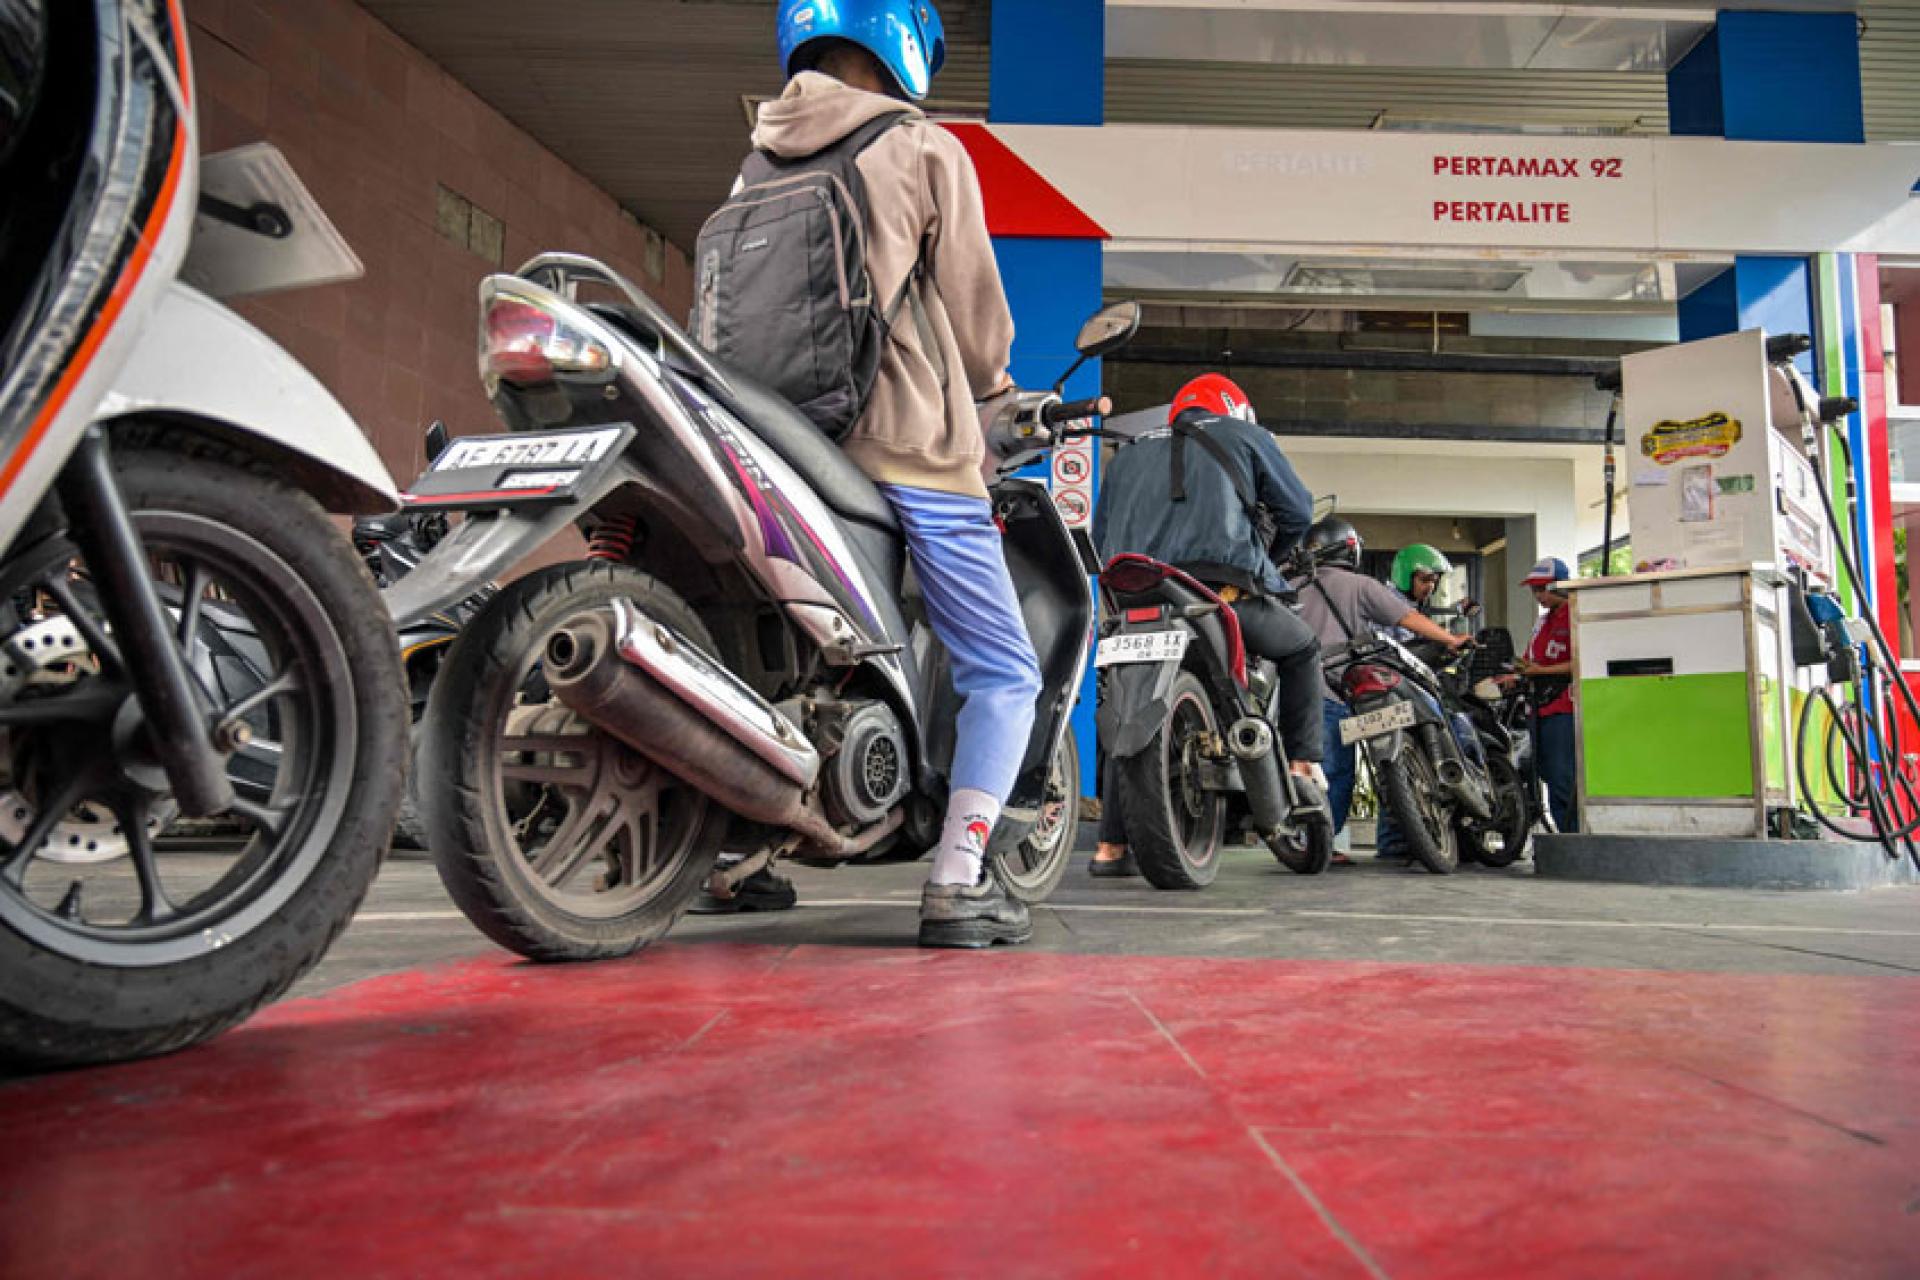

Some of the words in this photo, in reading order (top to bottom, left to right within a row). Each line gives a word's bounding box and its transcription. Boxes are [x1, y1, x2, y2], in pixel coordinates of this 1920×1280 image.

[1433, 156, 1579, 177] PERTAMAX
[1590, 158, 1623, 177] 92
[1433, 201, 1570, 223] PERTALITE
